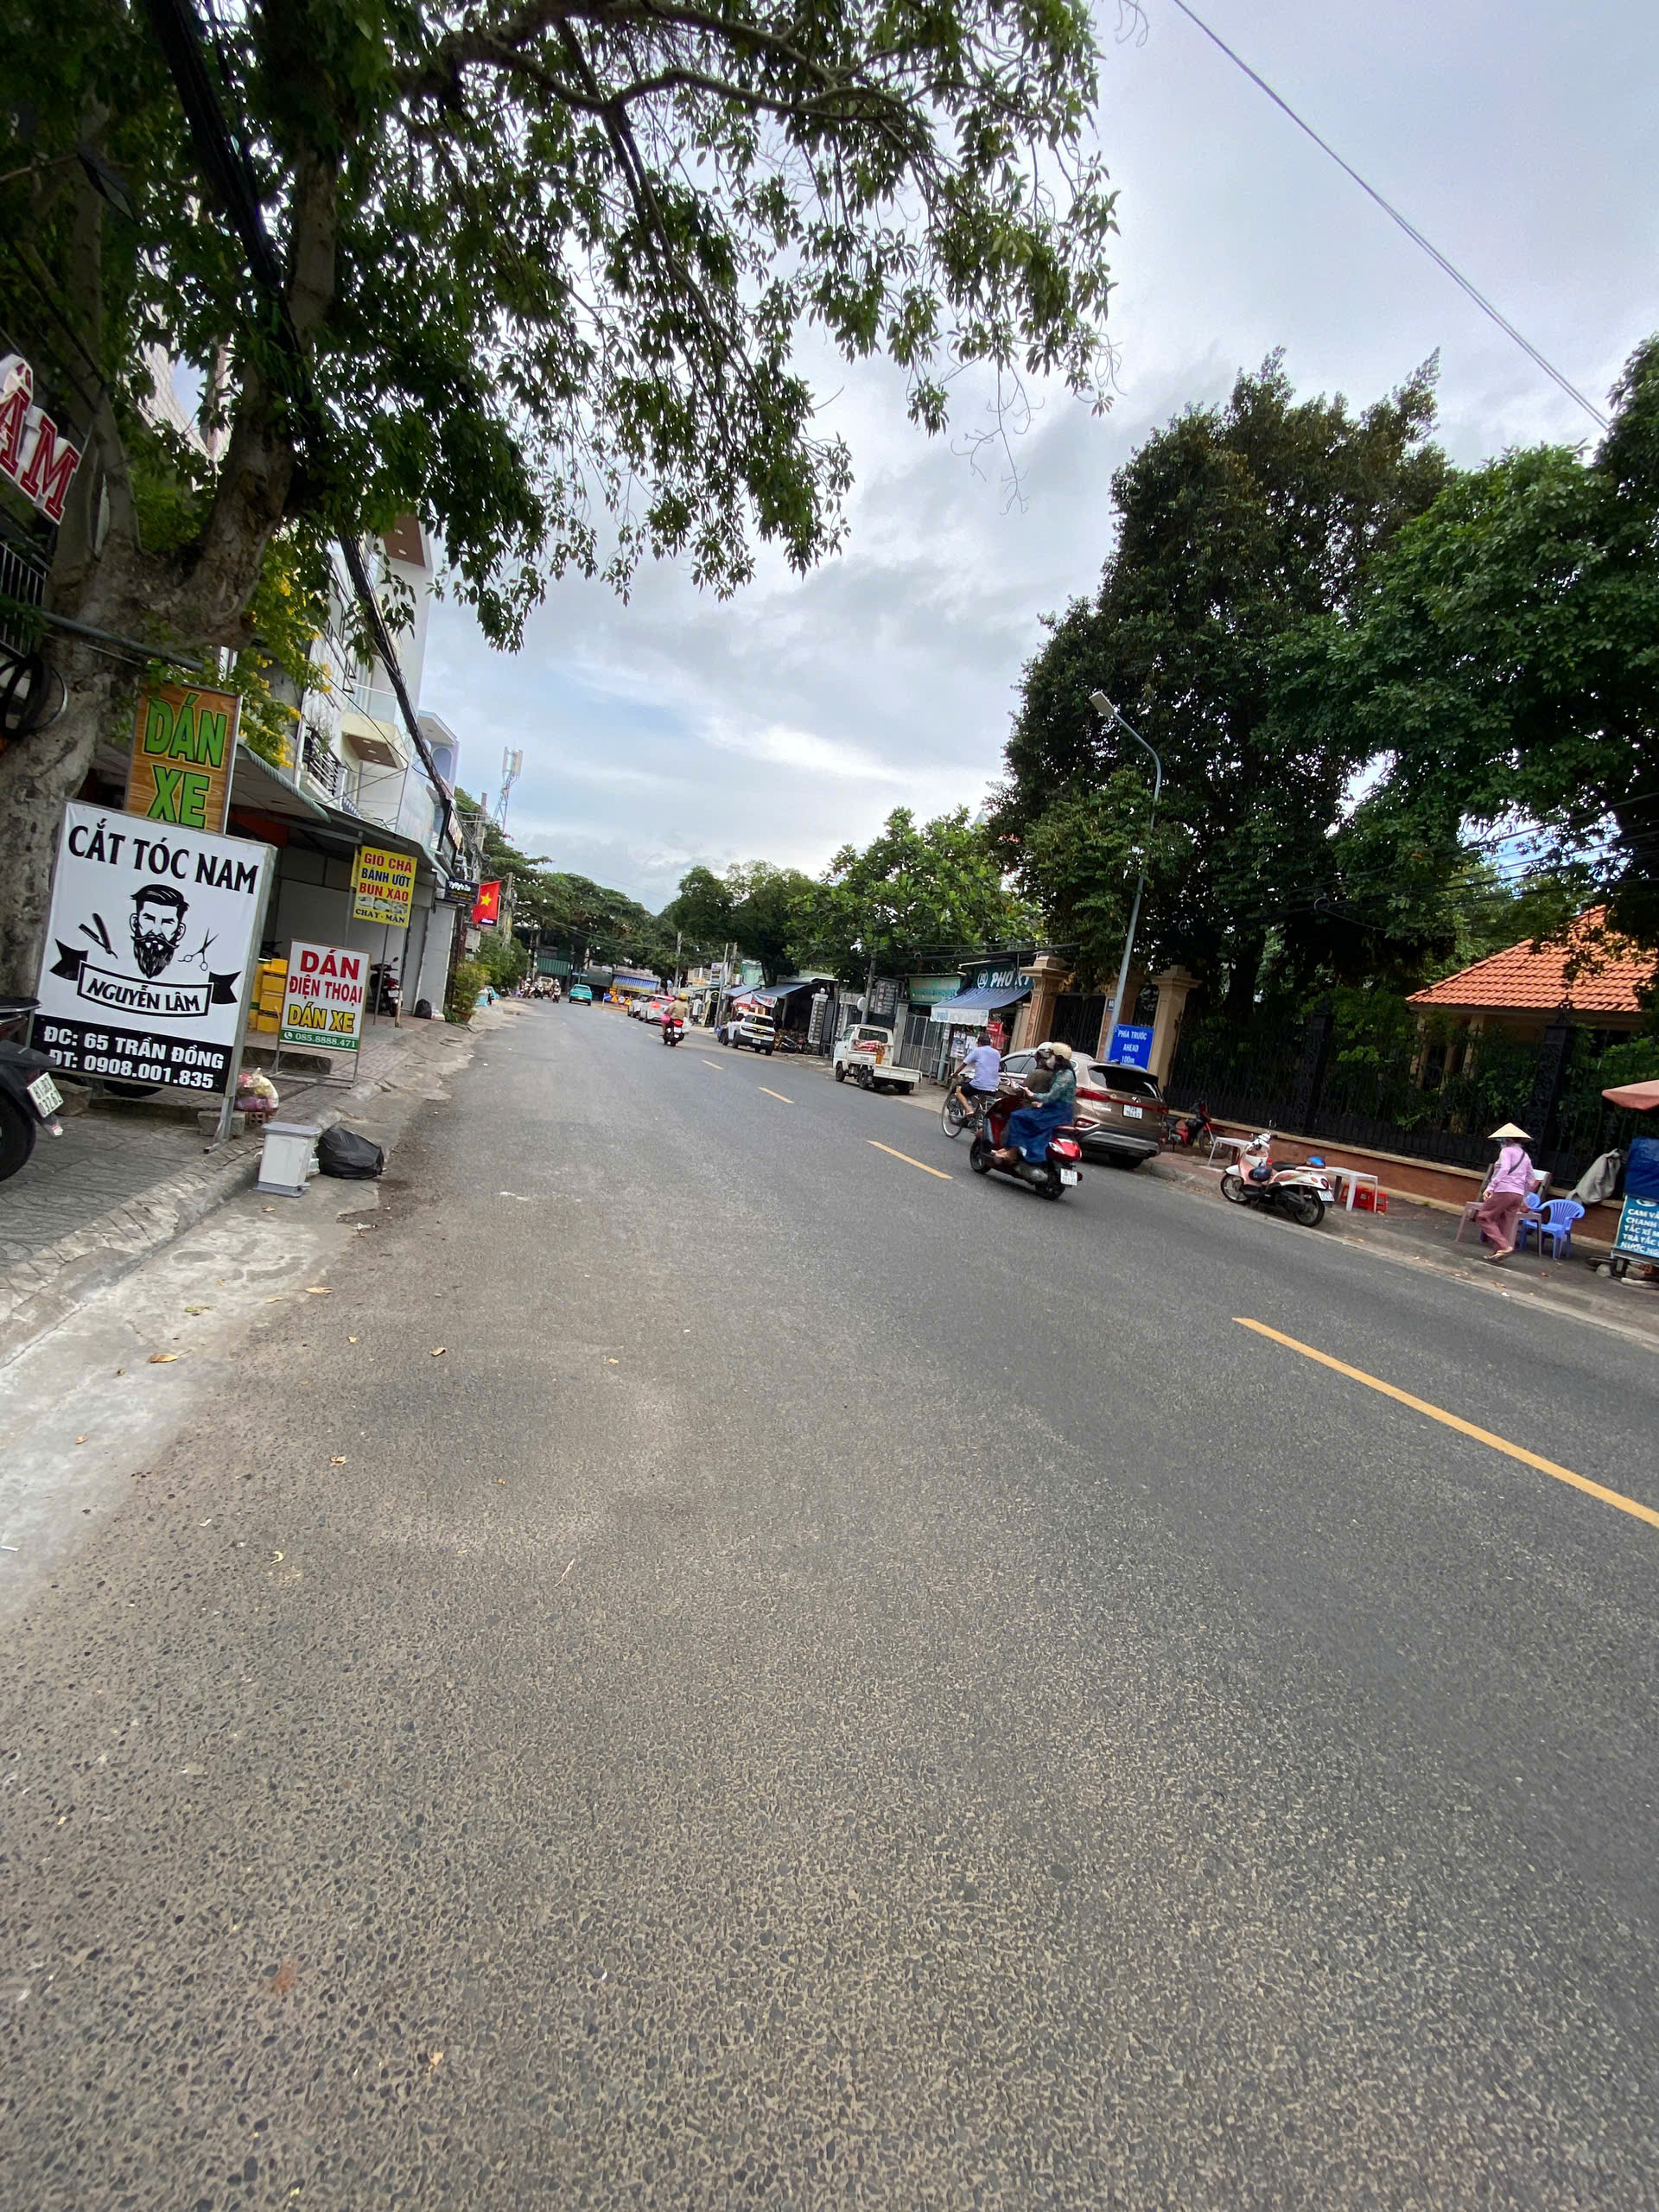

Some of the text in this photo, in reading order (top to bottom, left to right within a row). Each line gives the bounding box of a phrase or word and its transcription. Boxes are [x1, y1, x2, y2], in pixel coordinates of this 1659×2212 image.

[144, 692, 228, 768] DÁN
[147, 764, 211, 830] XE
[68, 817, 259, 895] CẮT TÓC NAM
[359, 881, 409, 902] BÚN XÀO
[361, 867, 411, 887] BÁNH ƯỚT
[355, 908, 380, 918] CHAY
[300, 949, 360, 981] DÁN
[86, 977, 200, 1012] NGUYỄN LÂM
[289, 974, 363, 1007] ĐIỆN THOẠI
[288, 1001, 355, 1033] DÁN XE
[43, 1025, 225, 1070] ĐC: 65 TRẦN ĐỒNG
[295, 1033, 357, 1048] 085.8888.471
[1122, 1043, 1139, 1052] AHEAD
[84, 1054, 214, 1089] 0908.001.835
[1121, 1055, 1135, 1065] 100m
[1625, 1217, 1657, 1228] CHANH
[1627, 1208, 1648, 1217] CAM
